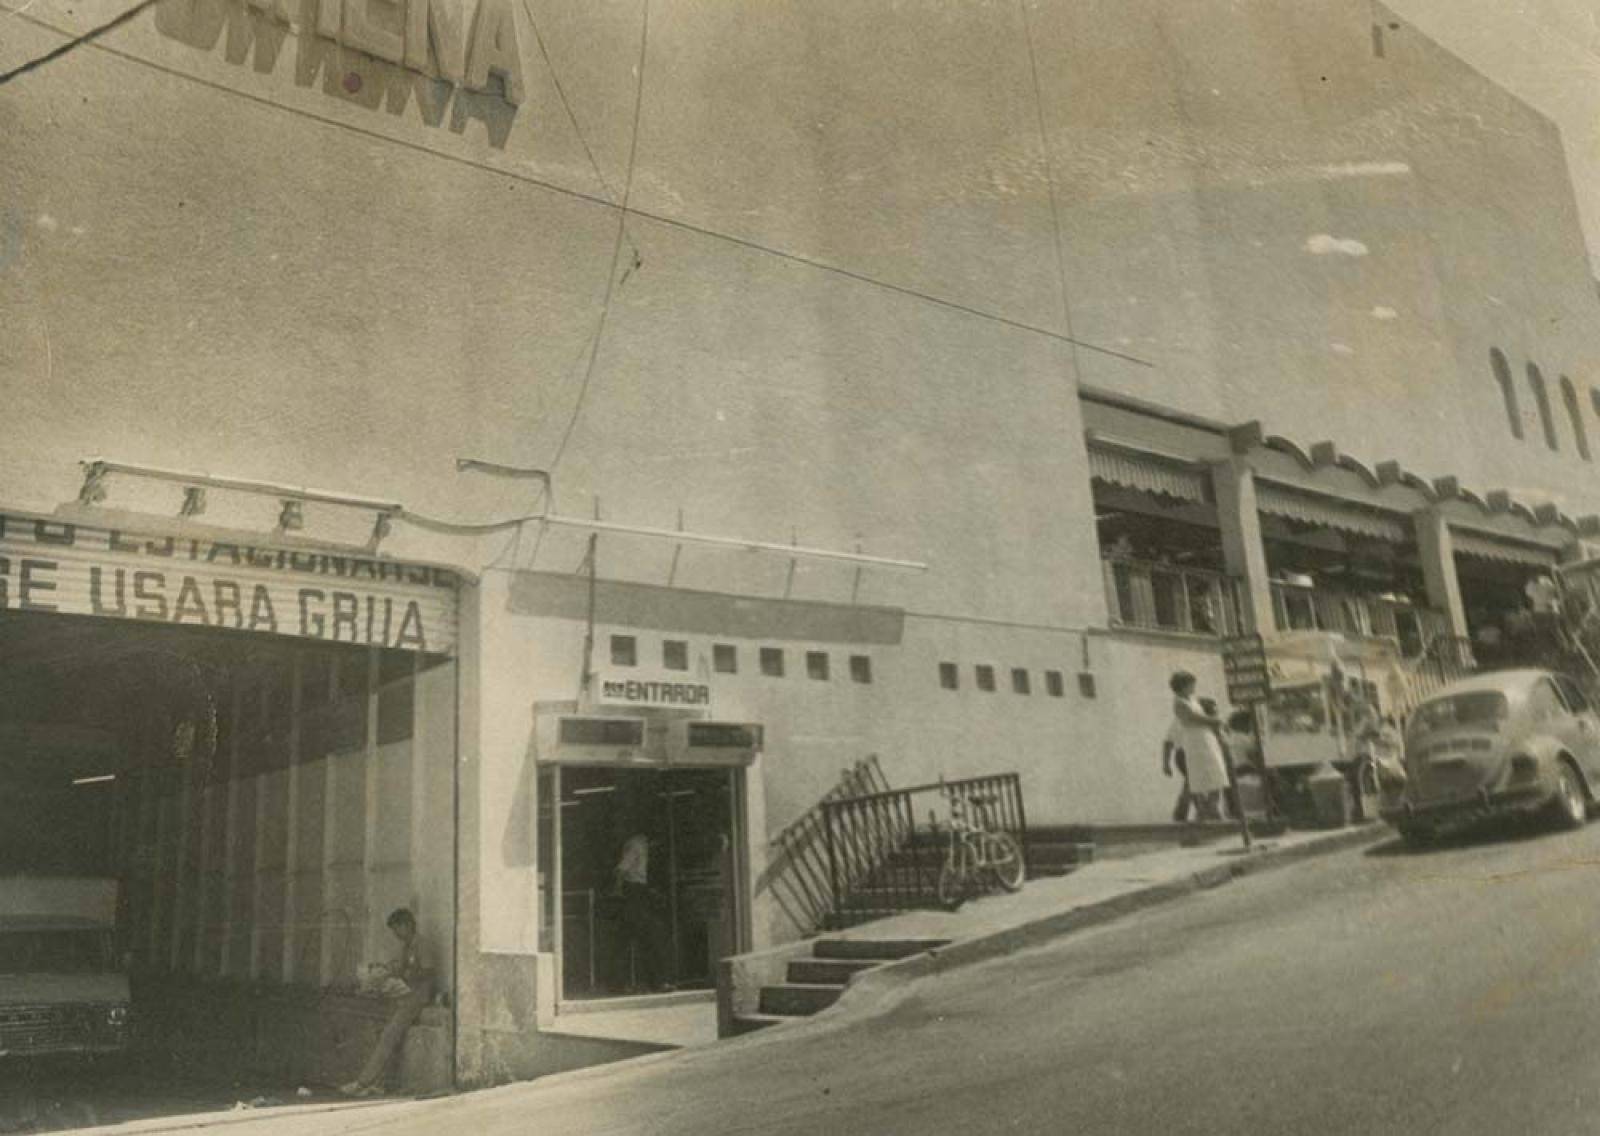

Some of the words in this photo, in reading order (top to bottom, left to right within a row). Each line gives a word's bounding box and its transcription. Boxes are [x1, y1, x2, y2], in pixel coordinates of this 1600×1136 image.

[0, 557, 57, 612] E
[90, 567, 278, 633] USARA
[298, 588, 425, 650] GRUA
[625, 680, 709, 704] ENTRADA
